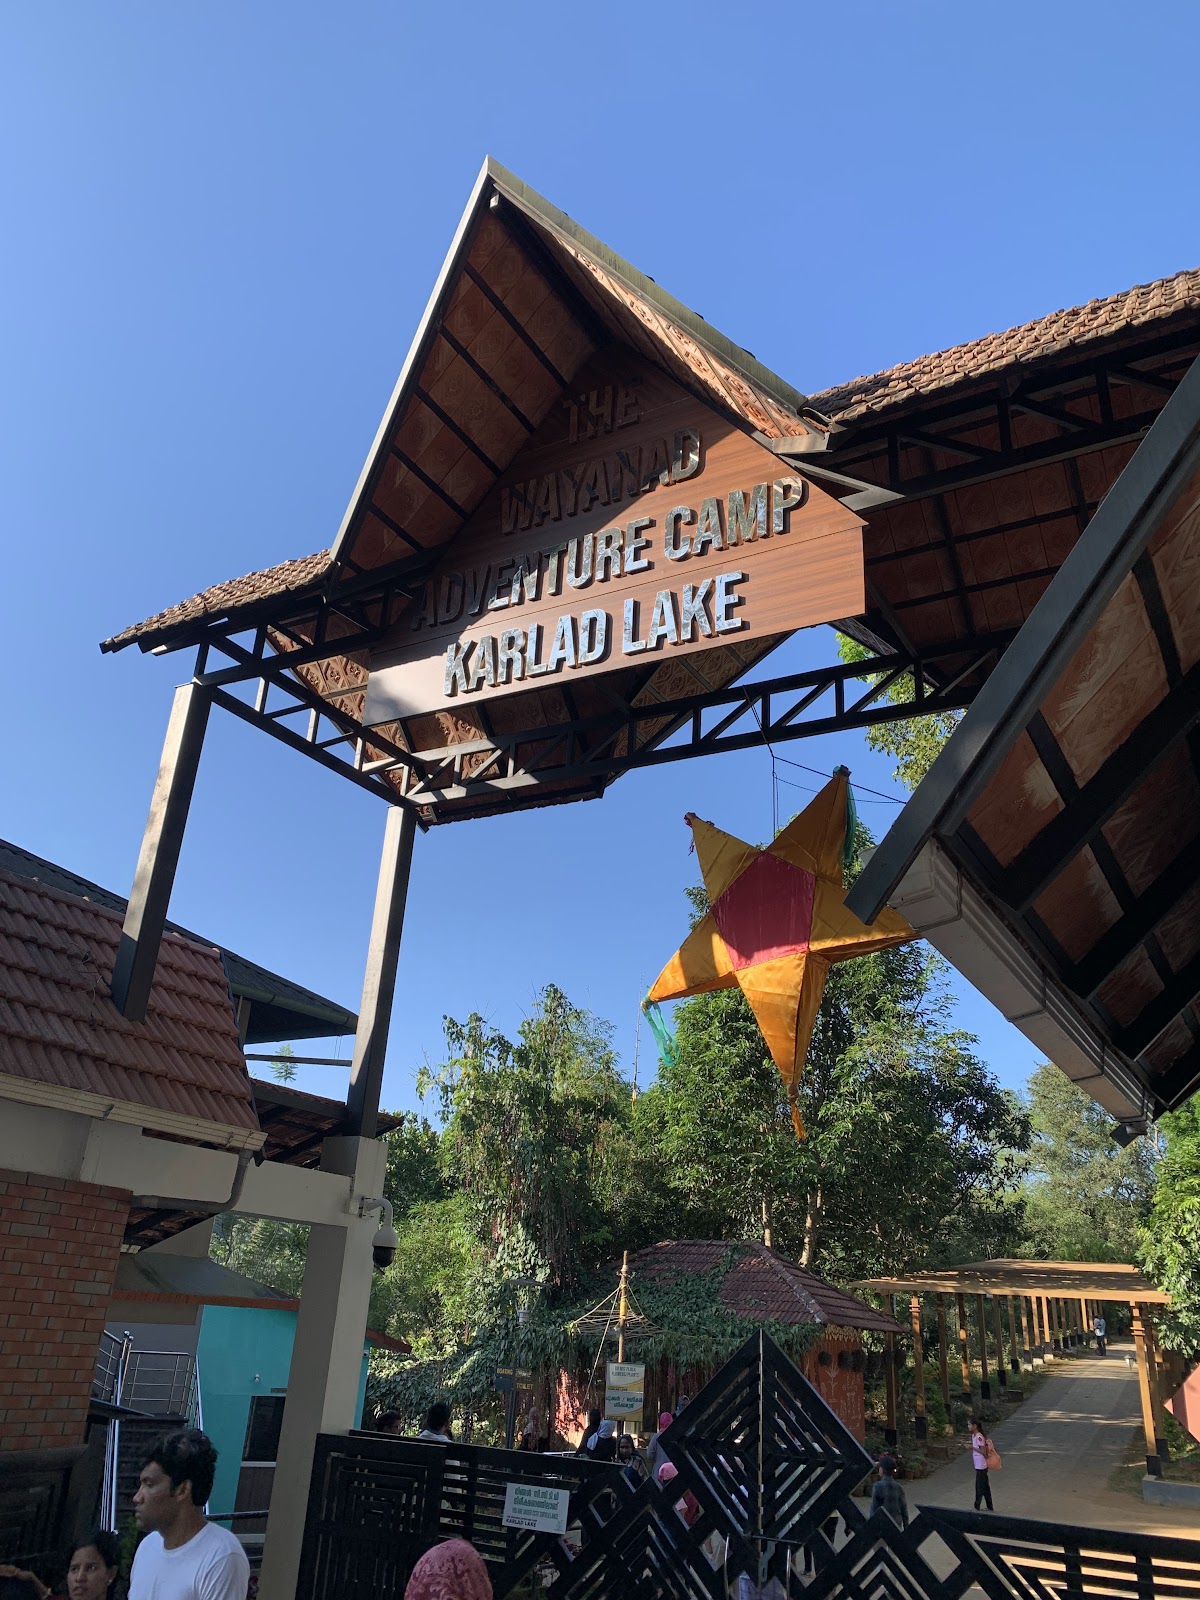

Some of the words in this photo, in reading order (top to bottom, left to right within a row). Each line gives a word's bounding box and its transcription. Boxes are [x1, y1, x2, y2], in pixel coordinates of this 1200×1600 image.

[563, 382, 641, 444] THE
[501, 427, 704, 535] WAYANAD
[410, 516, 656, 631] ADVENTURE
[664, 476, 808, 561] CAMP
[443, 608, 611, 696] KARLAD
[622, 570, 749, 655] LAKE
